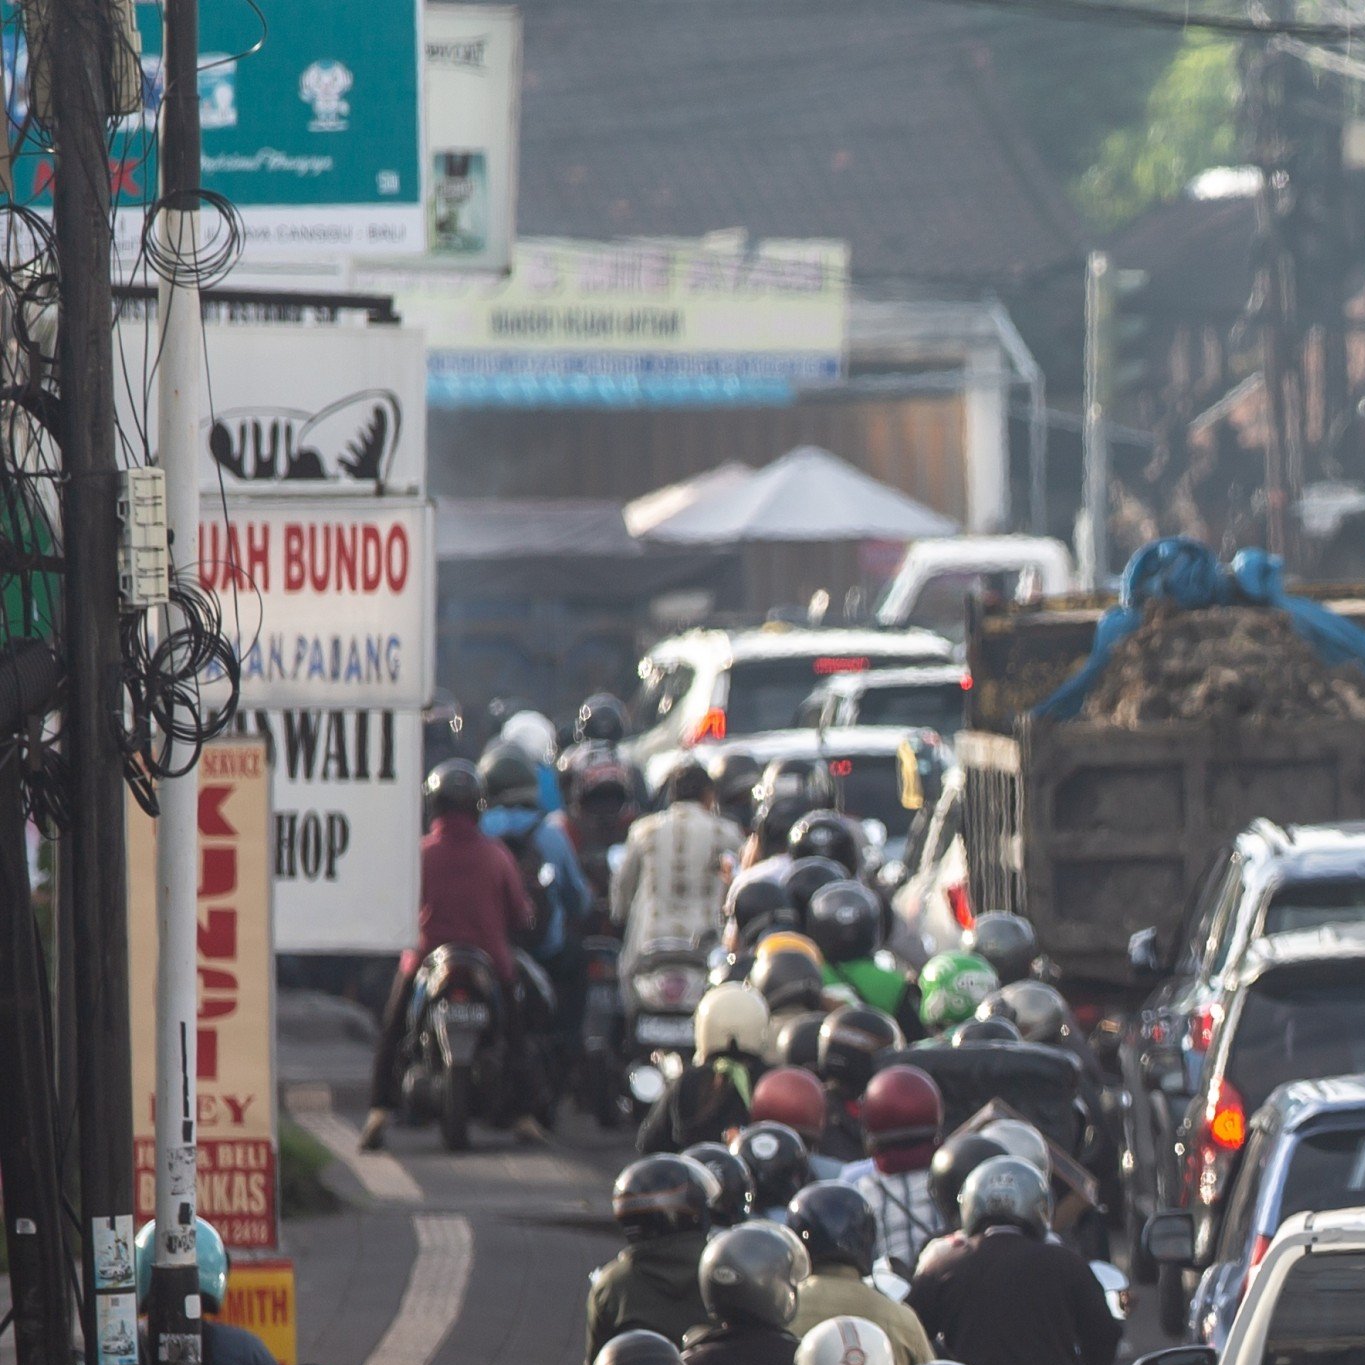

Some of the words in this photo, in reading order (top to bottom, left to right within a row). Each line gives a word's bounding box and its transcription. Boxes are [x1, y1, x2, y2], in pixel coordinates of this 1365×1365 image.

[283, 521, 410, 594] BUNDO
[294, 634, 401, 684] PADANG
[203, 752, 262, 778] SERVICE
[218, 1142, 268, 1169] BELI
[140, 1172, 267, 1216] BNKAS
